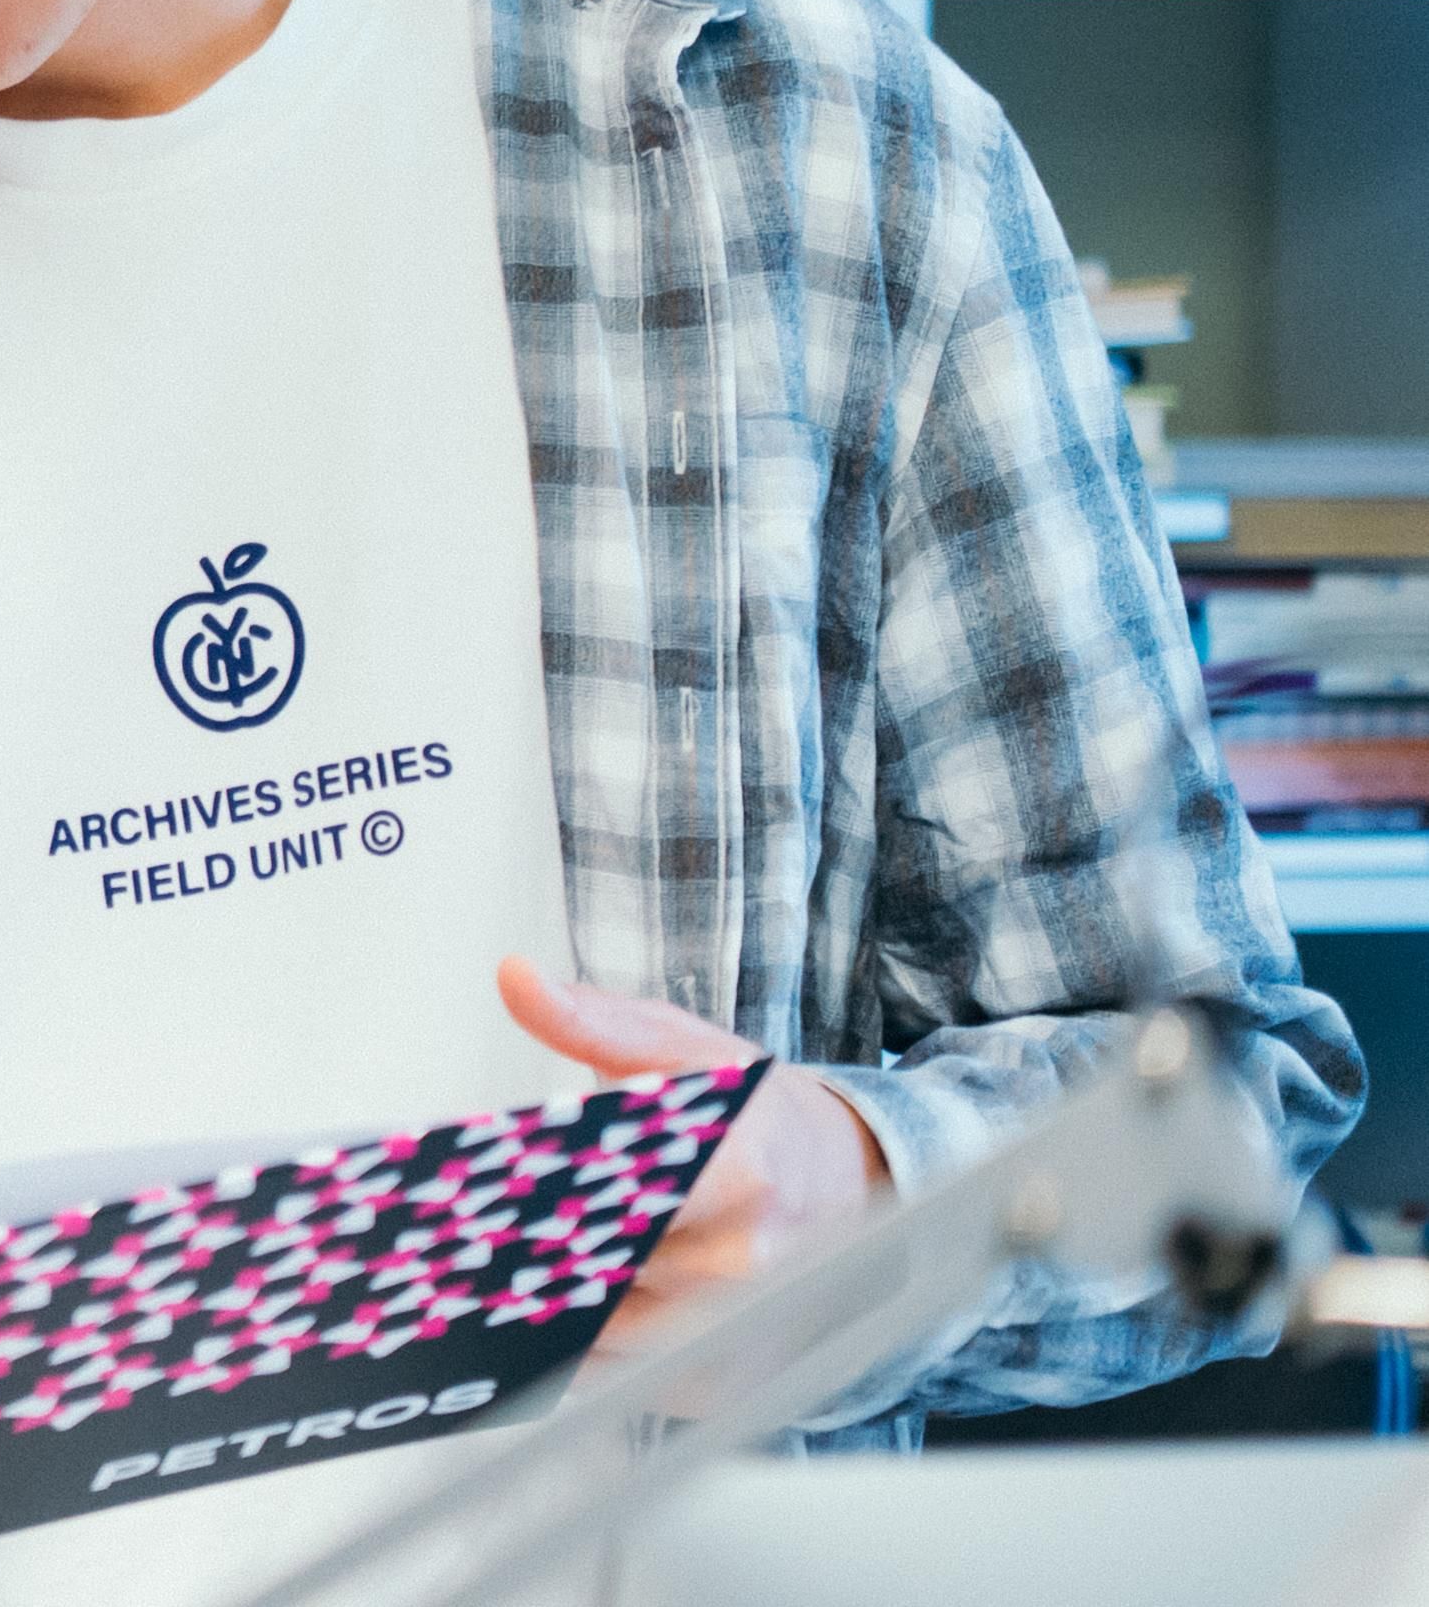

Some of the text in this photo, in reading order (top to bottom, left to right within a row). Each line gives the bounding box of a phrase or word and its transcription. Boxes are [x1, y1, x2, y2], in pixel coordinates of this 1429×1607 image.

[48, 742, 453, 856] ARCHIVES SERIES
[101, 853, 237, 909] FIELD
[249, 822, 349, 880] UNIT
[90, 1378, 499, 1492] PETROS
